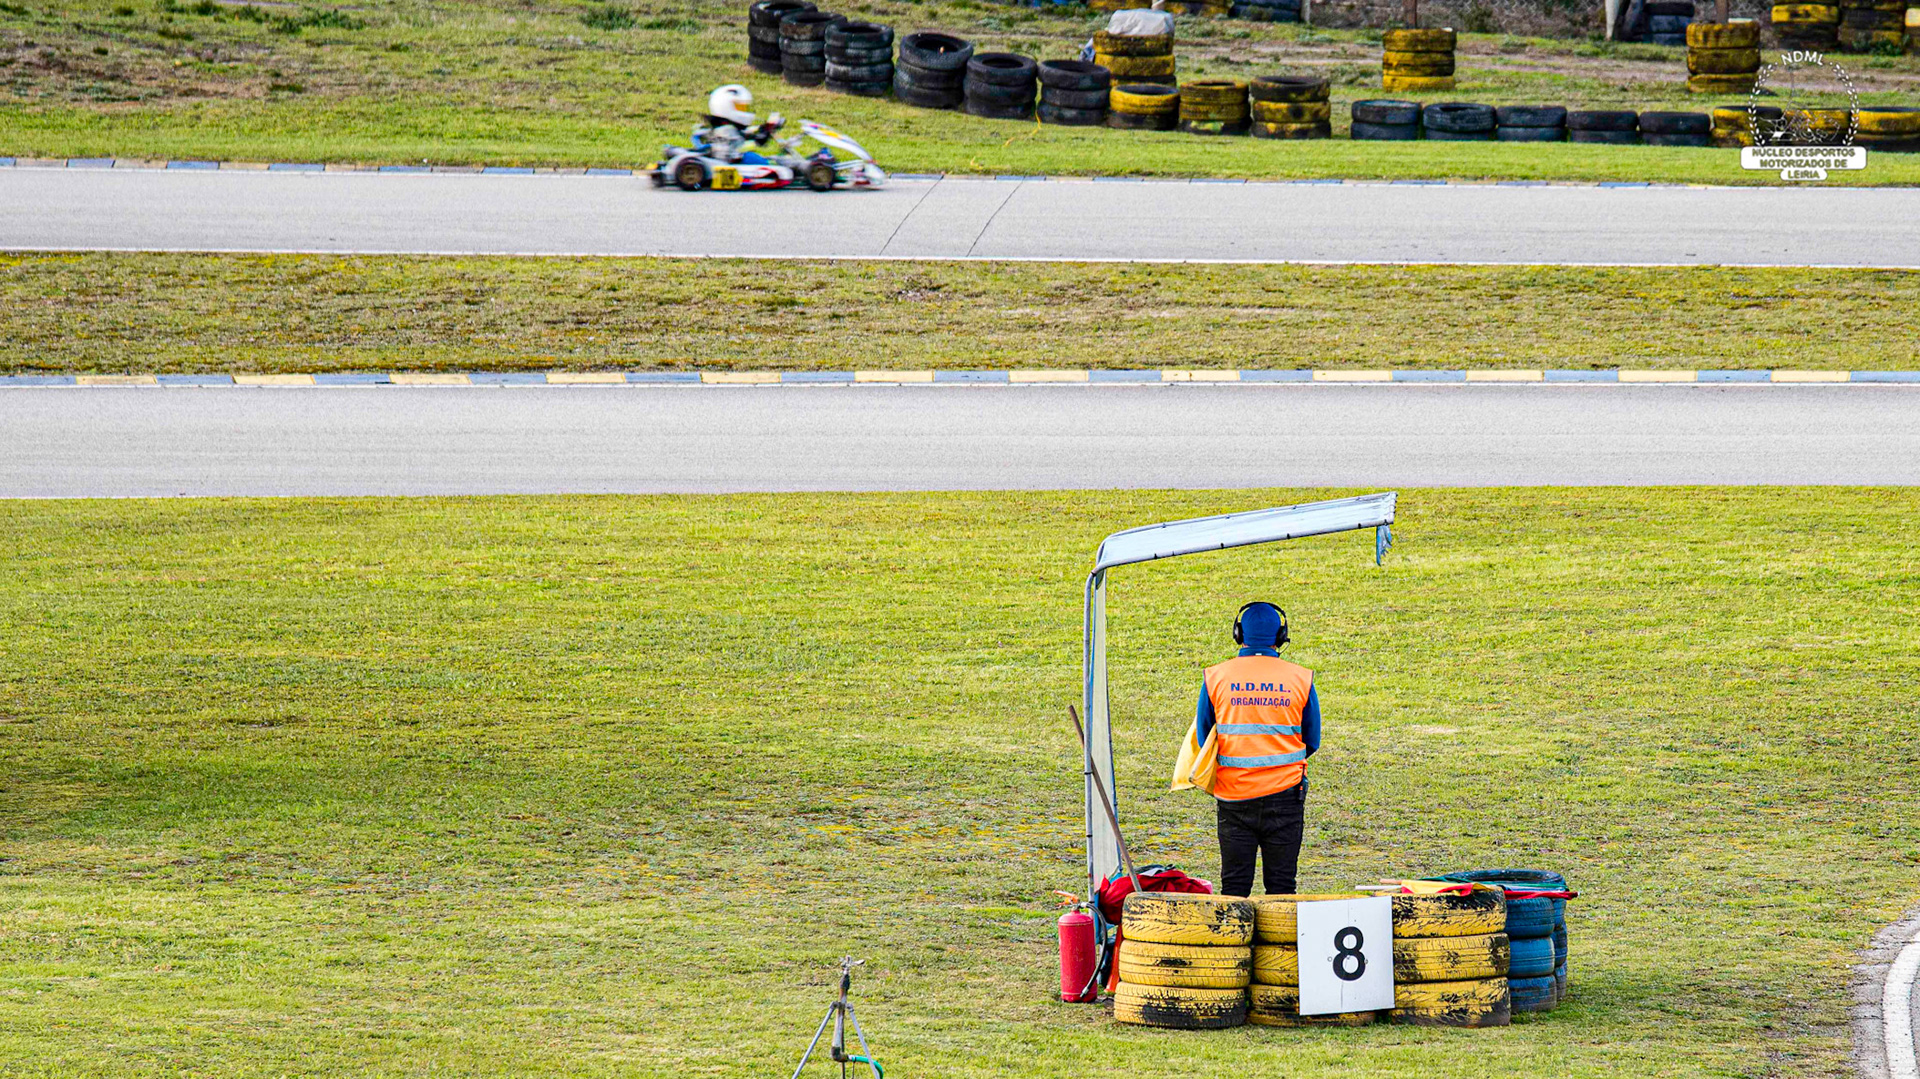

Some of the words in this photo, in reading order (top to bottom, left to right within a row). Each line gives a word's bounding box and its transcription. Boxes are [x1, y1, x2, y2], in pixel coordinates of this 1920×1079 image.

[1230, 682, 1291, 693] N.D.M.L.
[1230, 695, 1291, 708] ORGANIZAÇÃO
[1332, 926, 1366, 981] 8
